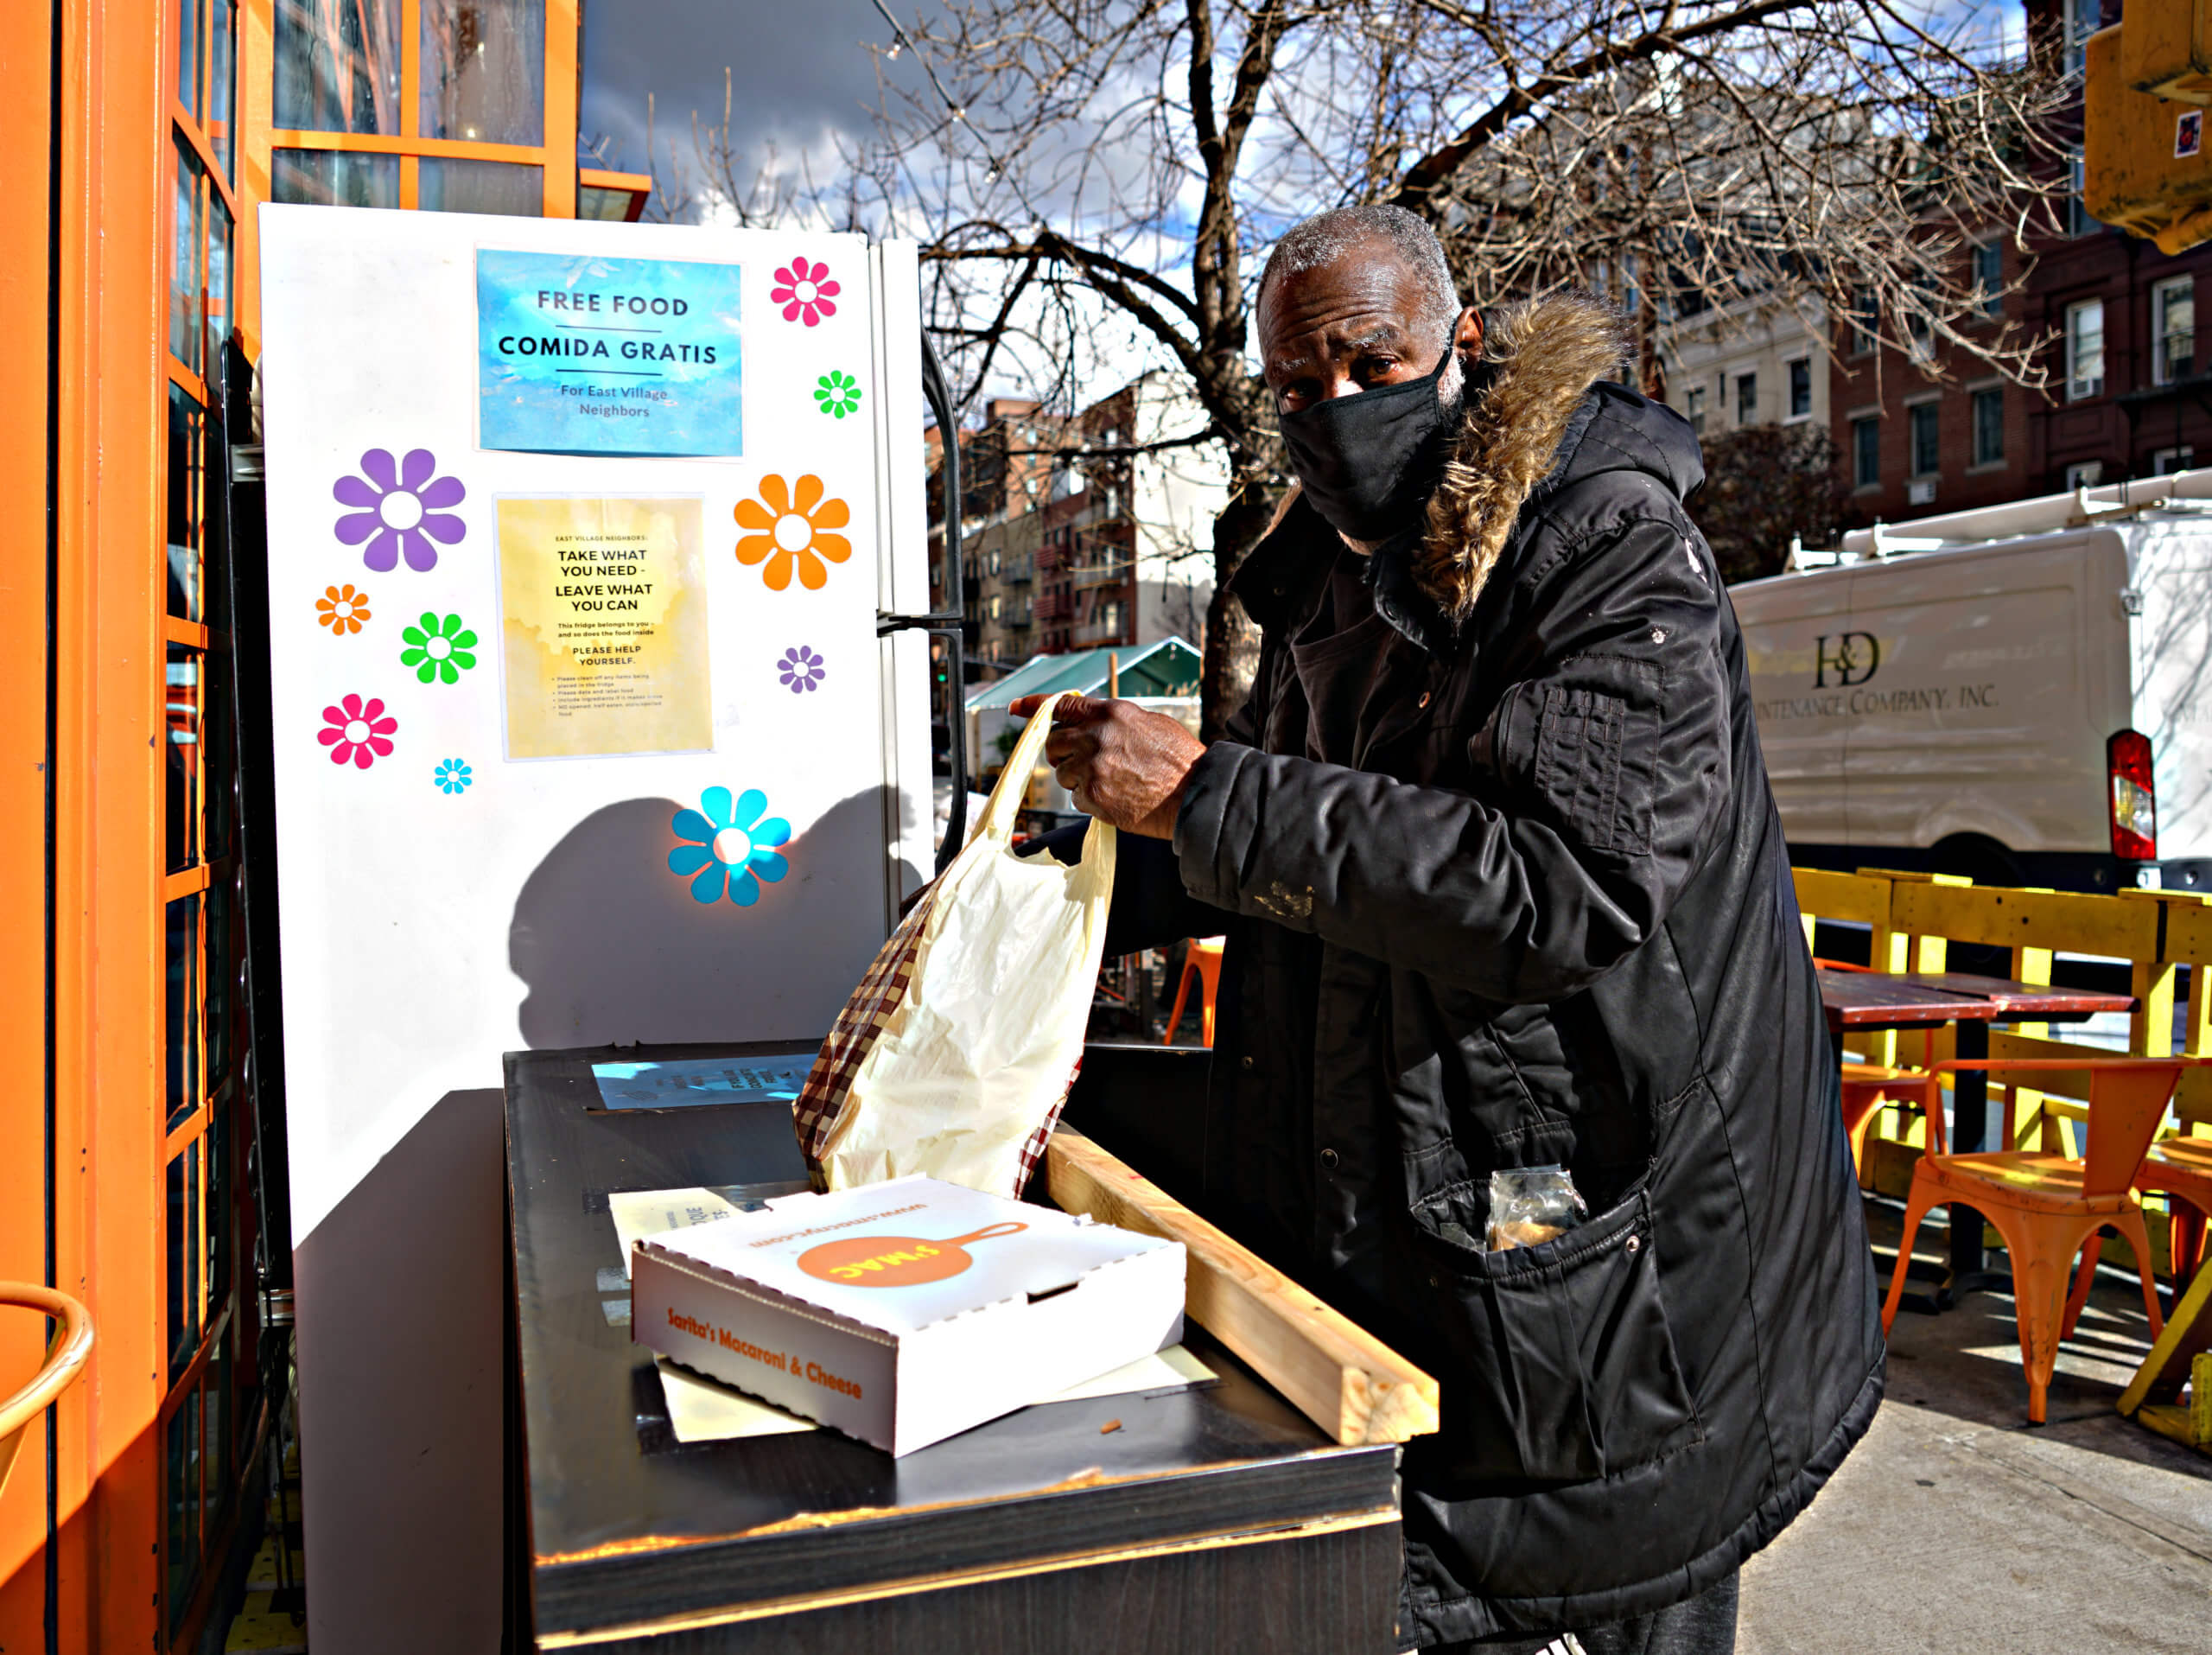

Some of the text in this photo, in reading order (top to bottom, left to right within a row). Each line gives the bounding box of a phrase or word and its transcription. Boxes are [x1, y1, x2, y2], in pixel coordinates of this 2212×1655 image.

[538, 290, 689, 316] FREE FOOD
[499, 335, 716, 364] COMIDA GRATIS
[562, 385, 668, 401] For East Village
[580, 404, 650, 418] Neighbors
[557, 550, 647, 562] TAKE WHAT
[561, 566, 593, 576] YOU
[597, 565, 637, 576] NEED
[556, 583, 653, 596] LEAVE WHAT
[571, 599, 638, 612] YOU CAN
[573, 646, 641, 655] PLEASE HELP
[580, 657, 636, 666] YOURSELF.
[1812, 631, 1881, 689] H&D
[829, 1244, 940, 1279] S'MAC
[667, 1307, 862, 1400] Sarita's Macaroni & Cheese
